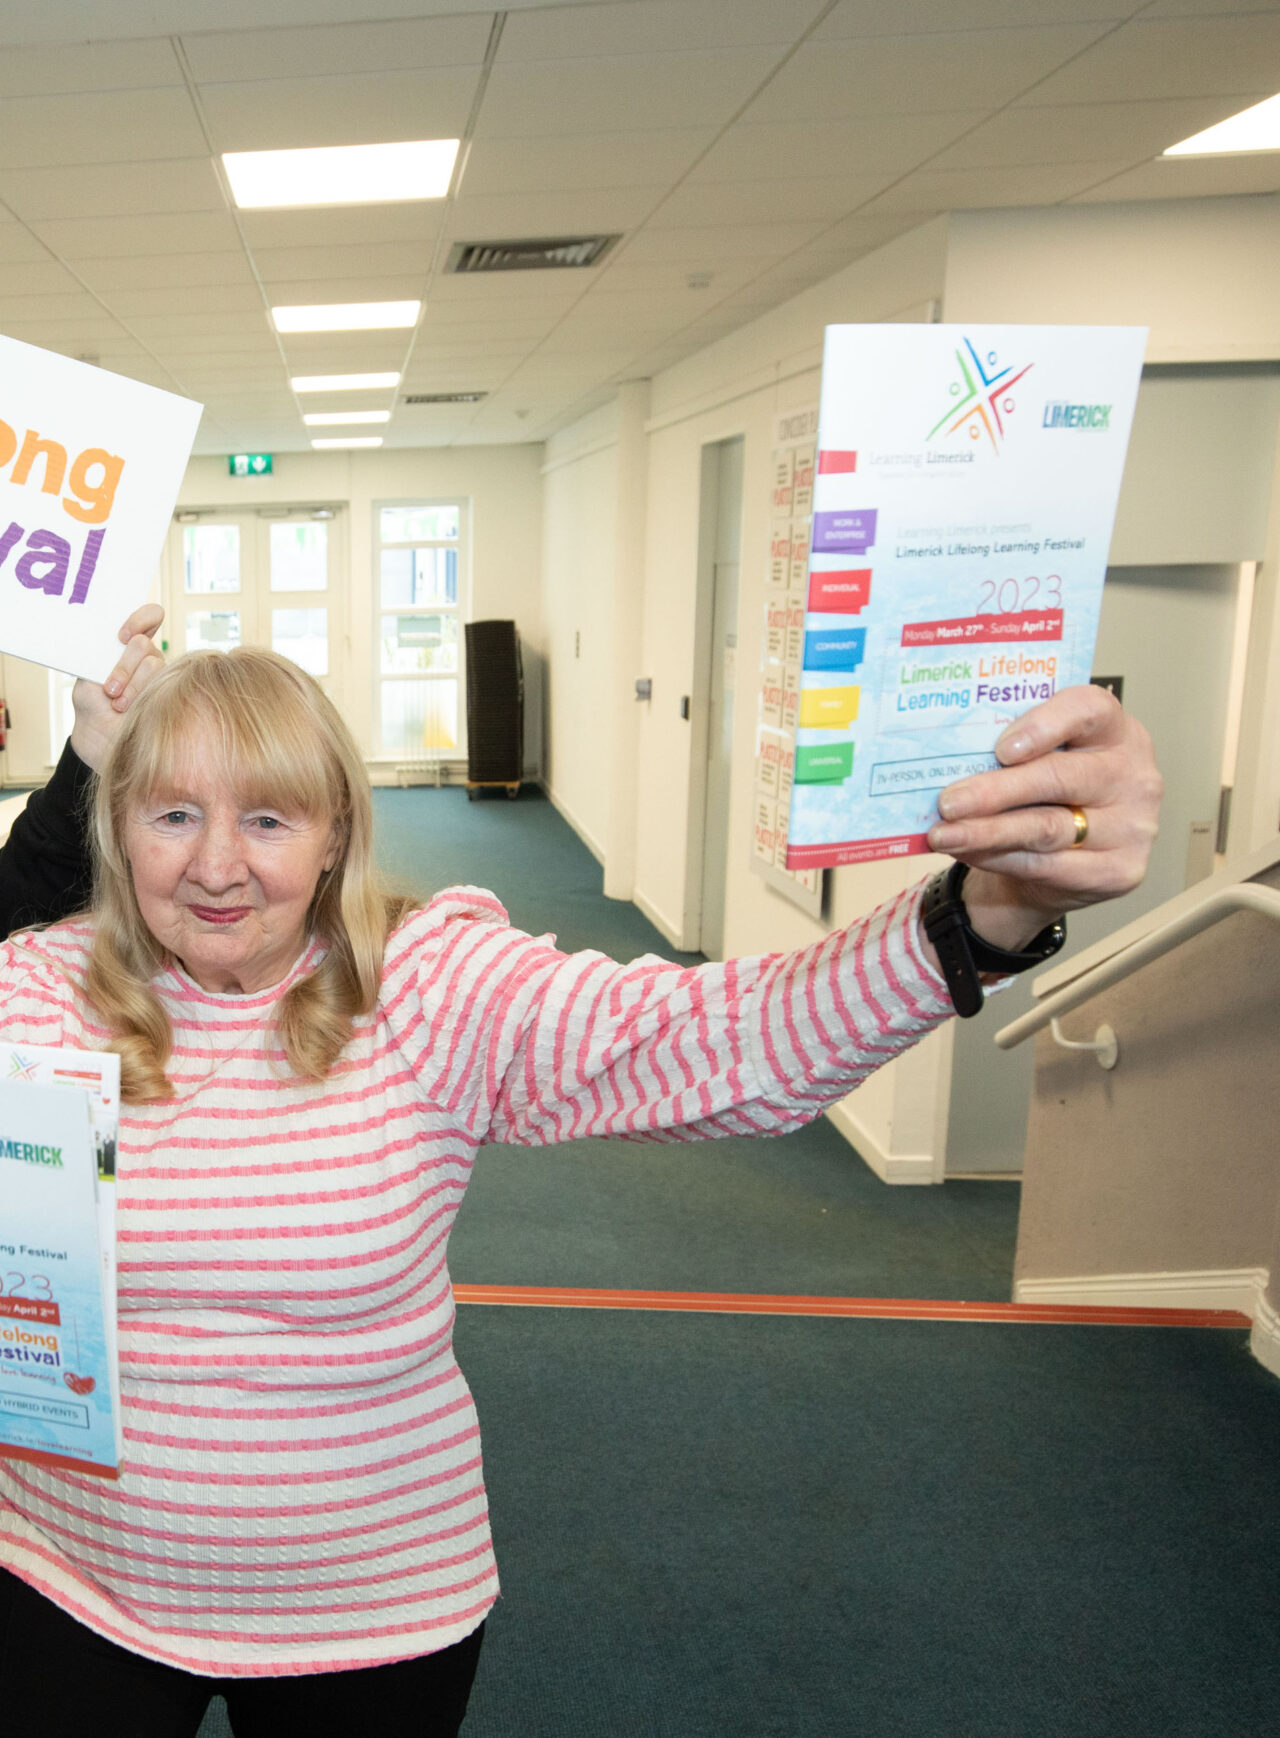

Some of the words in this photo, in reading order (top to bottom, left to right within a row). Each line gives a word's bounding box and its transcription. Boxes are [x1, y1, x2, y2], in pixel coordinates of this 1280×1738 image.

[1042, 404, 1112, 429] LIMERICK
[926, 450, 975, 464] Limerick
[896, 543, 943, 558] Limerick
[947, 541, 990, 558] Lifelong
[993, 539, 1040, 555] Learning
[1043, 537, 1086, 551] Festival
[976, 574, 1062, 616] 2023
[937, 626, 964, 639] March
[990, 622, 1021, 635] Sunday
[1022, 620, 1045, 634] April
[901, 661, 973, 685] Limerick
[978, 653, 1057, 678] Lifelong
[897, 688, 971, 712] Learning
[976, 678, 1055, 703] Festival
[929, 766, 964, 778] ONLINE
[964, 764, 986, 777] AND
[889, 843, 910, 855] FREE
[19, 1245, 68, 1261] Festival
[13, 1302, 37, 1317] April
[20, 1368, 57, 1384] learning
[3, 1399, 40, 1413] HYBRID
[42, 1405, 80, 1420] EVENTS
